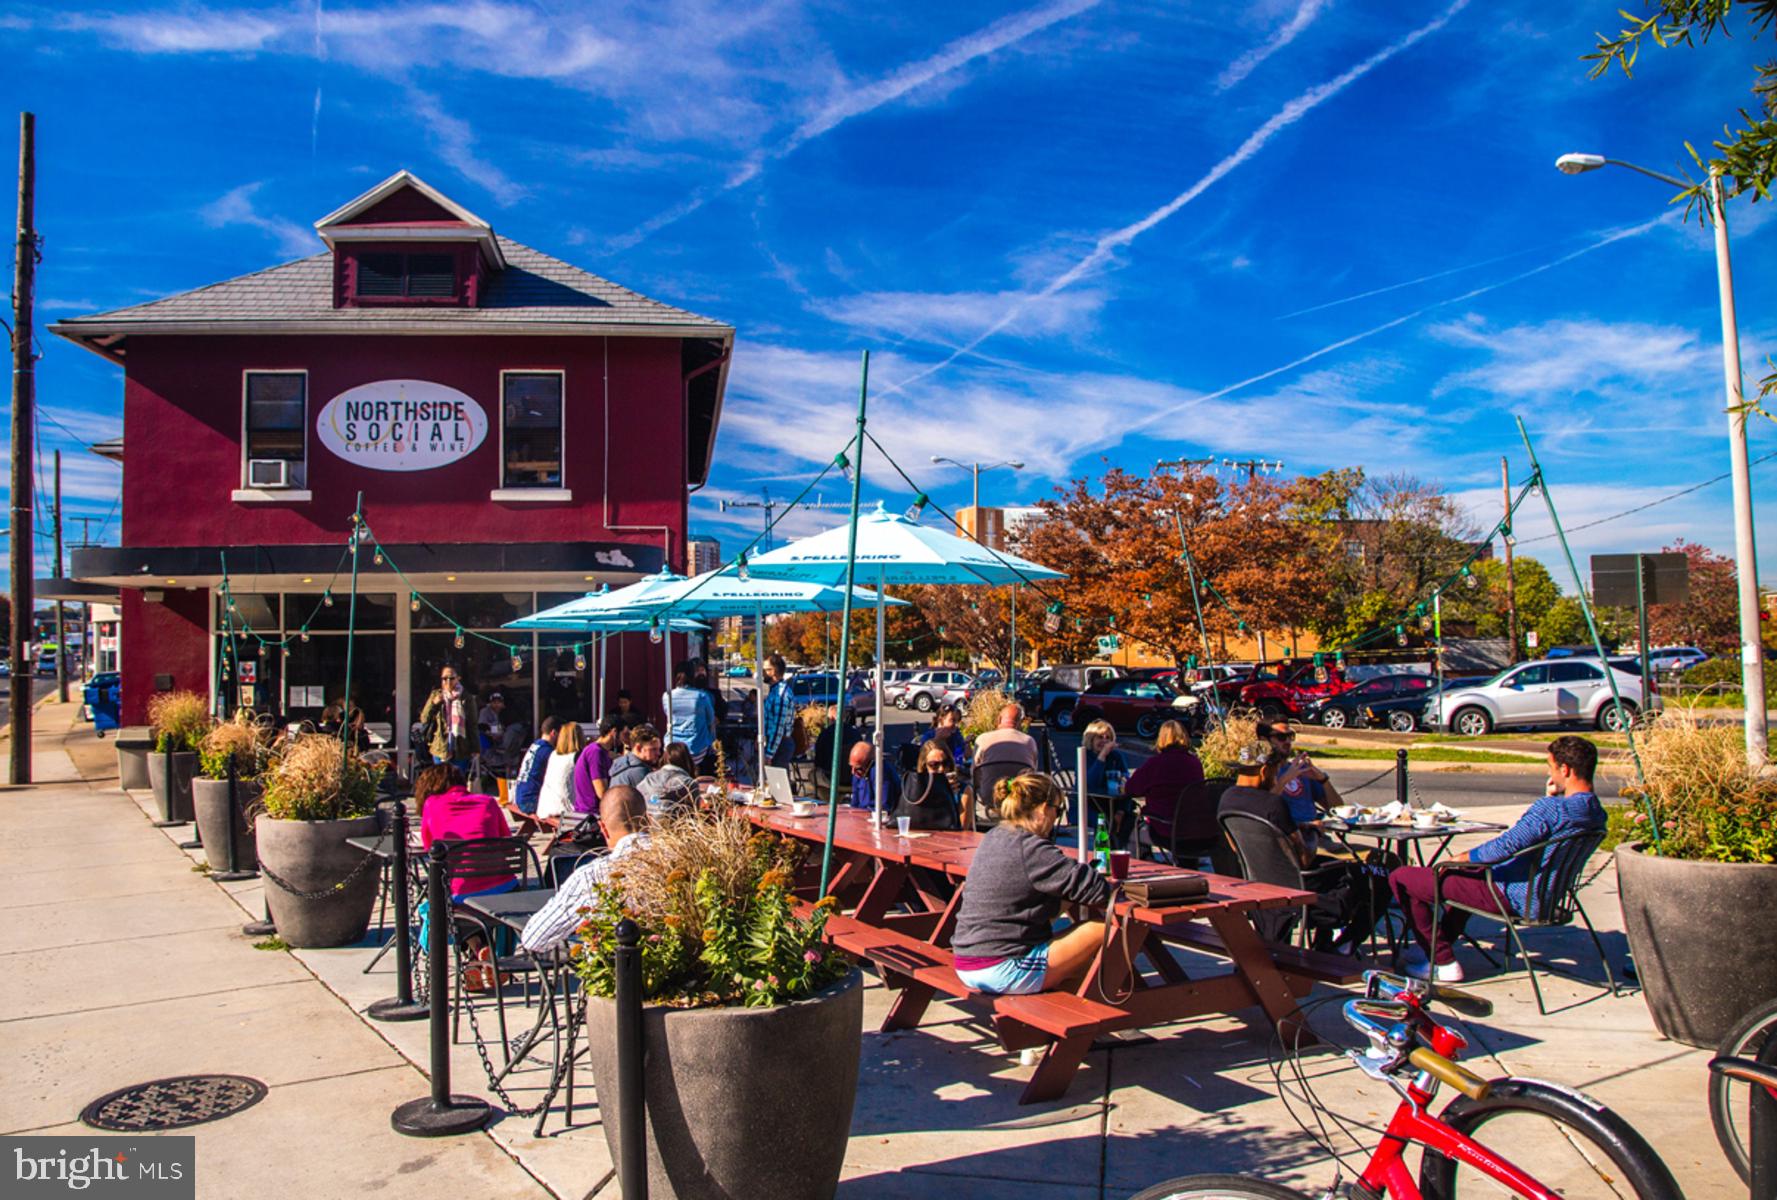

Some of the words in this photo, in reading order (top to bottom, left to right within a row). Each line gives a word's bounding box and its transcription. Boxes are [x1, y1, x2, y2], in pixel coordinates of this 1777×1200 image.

[346, 401, 465, 421] NORTHSIDE
[346, 422, 465, 442] SOCIAL
[345, 442, 400, 453] COFFEE
[411, 442, 418, 453] &
[429, 442, 465, 453] WINE
